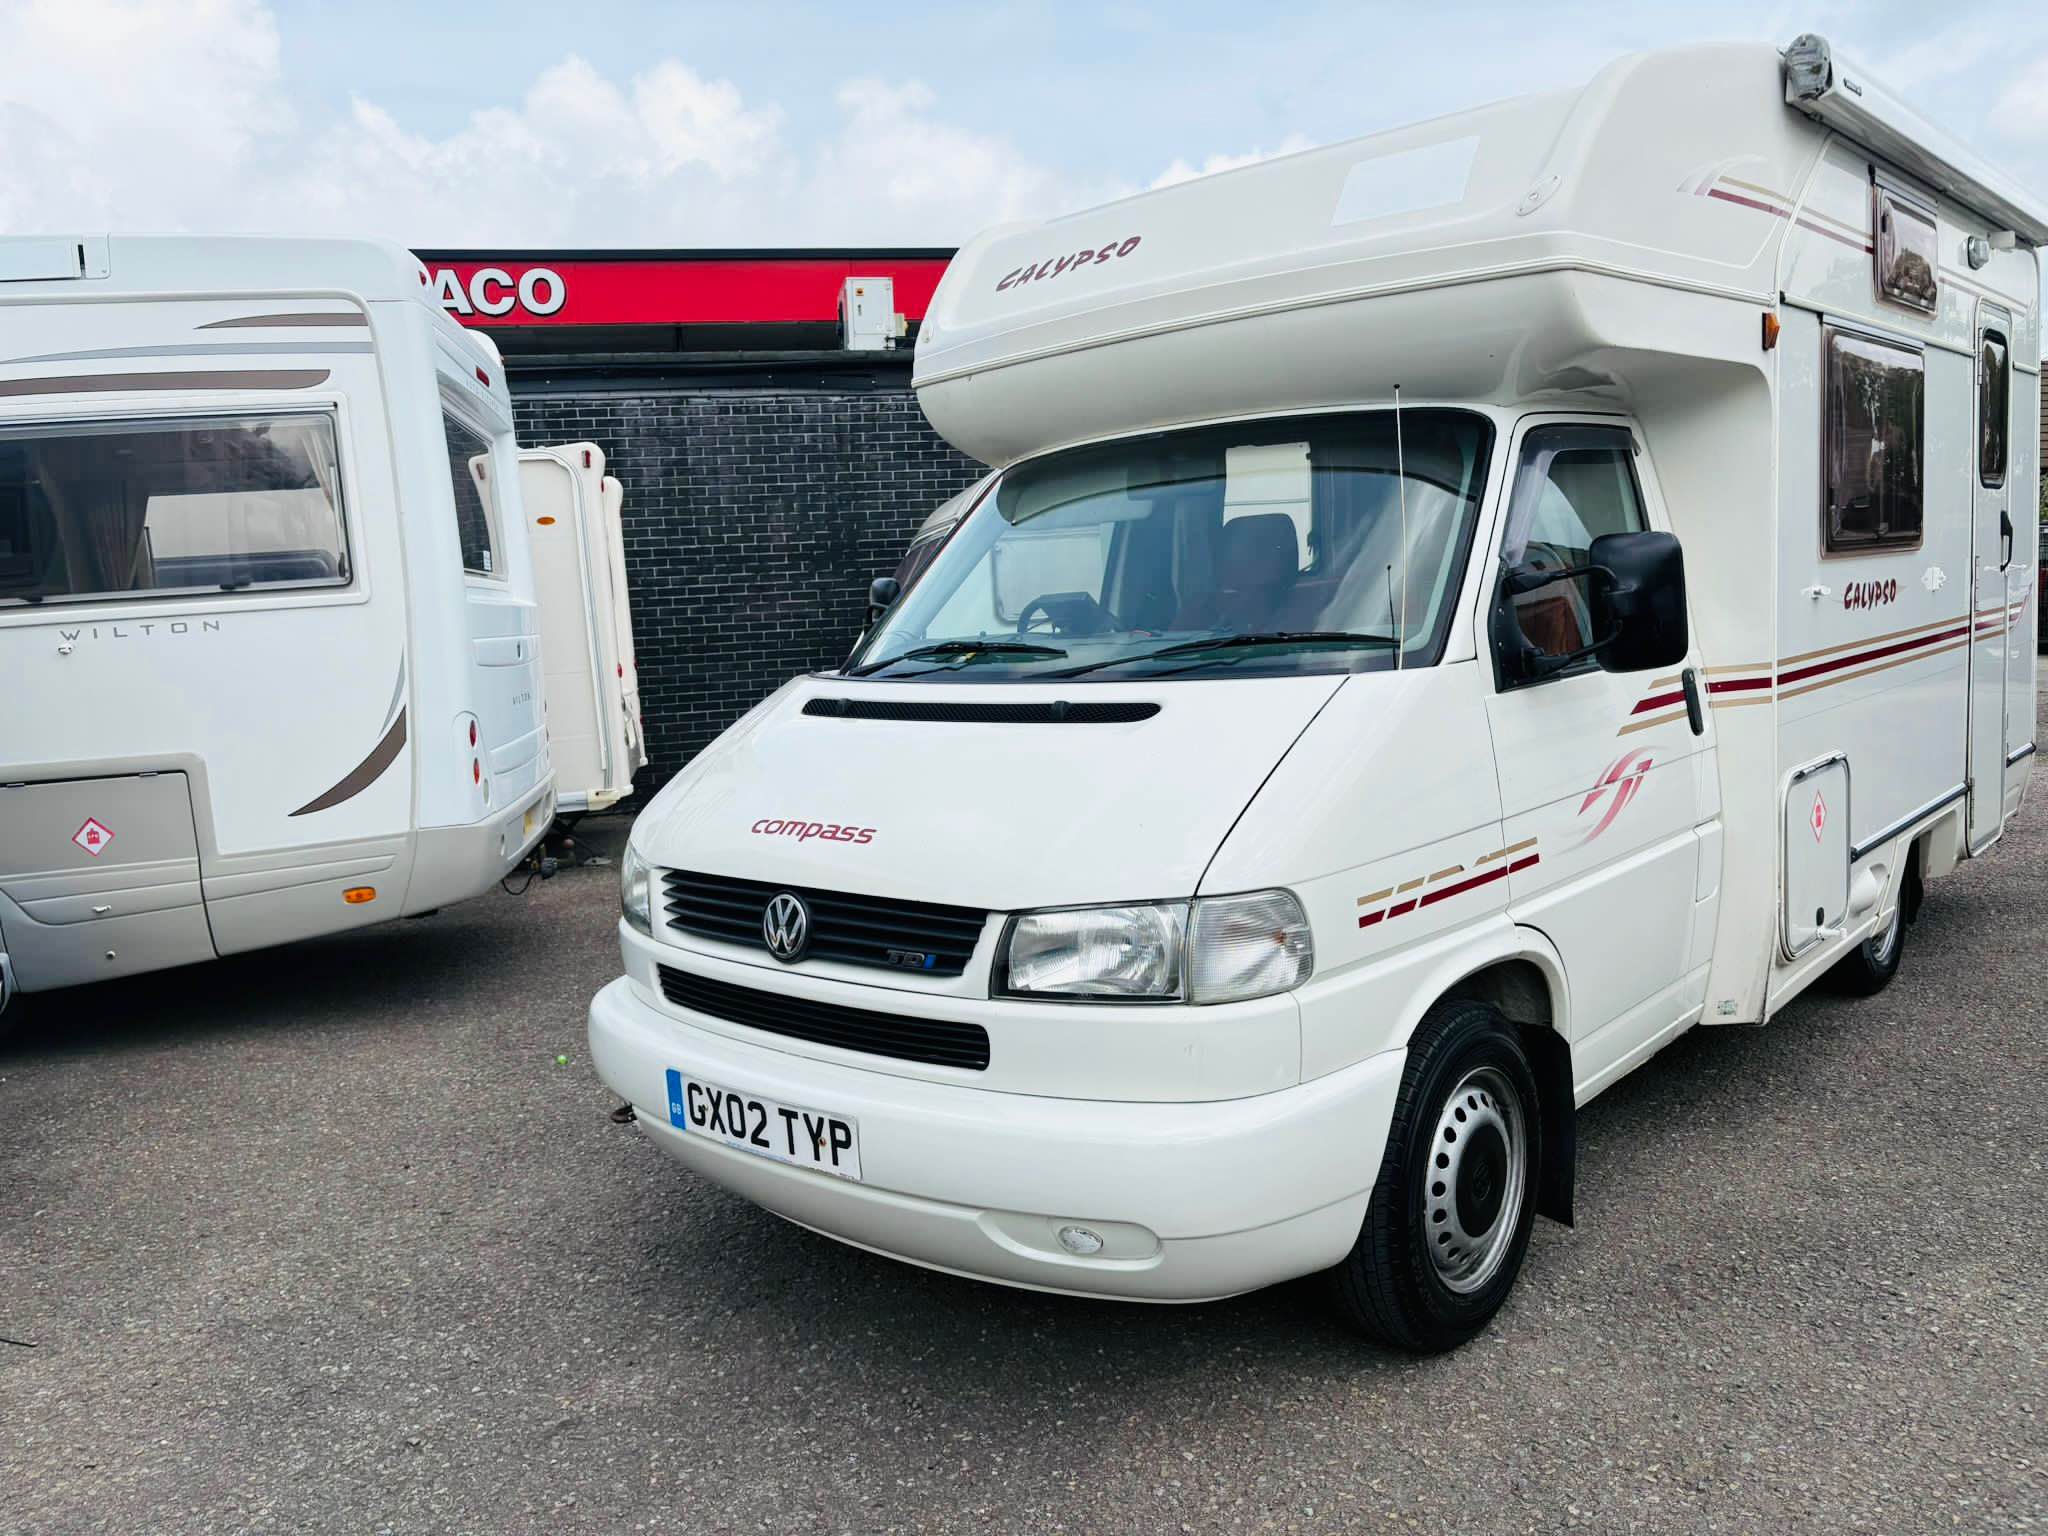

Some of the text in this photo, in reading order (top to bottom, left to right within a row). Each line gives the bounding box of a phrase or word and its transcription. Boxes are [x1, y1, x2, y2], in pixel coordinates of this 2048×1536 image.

[996, 236, 1142, 291] CALYPSO
[1844, 578, 1896, 611] CALYPSO
[60, 620, 219, 641] WILTON
[751, 819, 877, 844] compass
[687, 1082, 852, 1167] GX02 TYP
